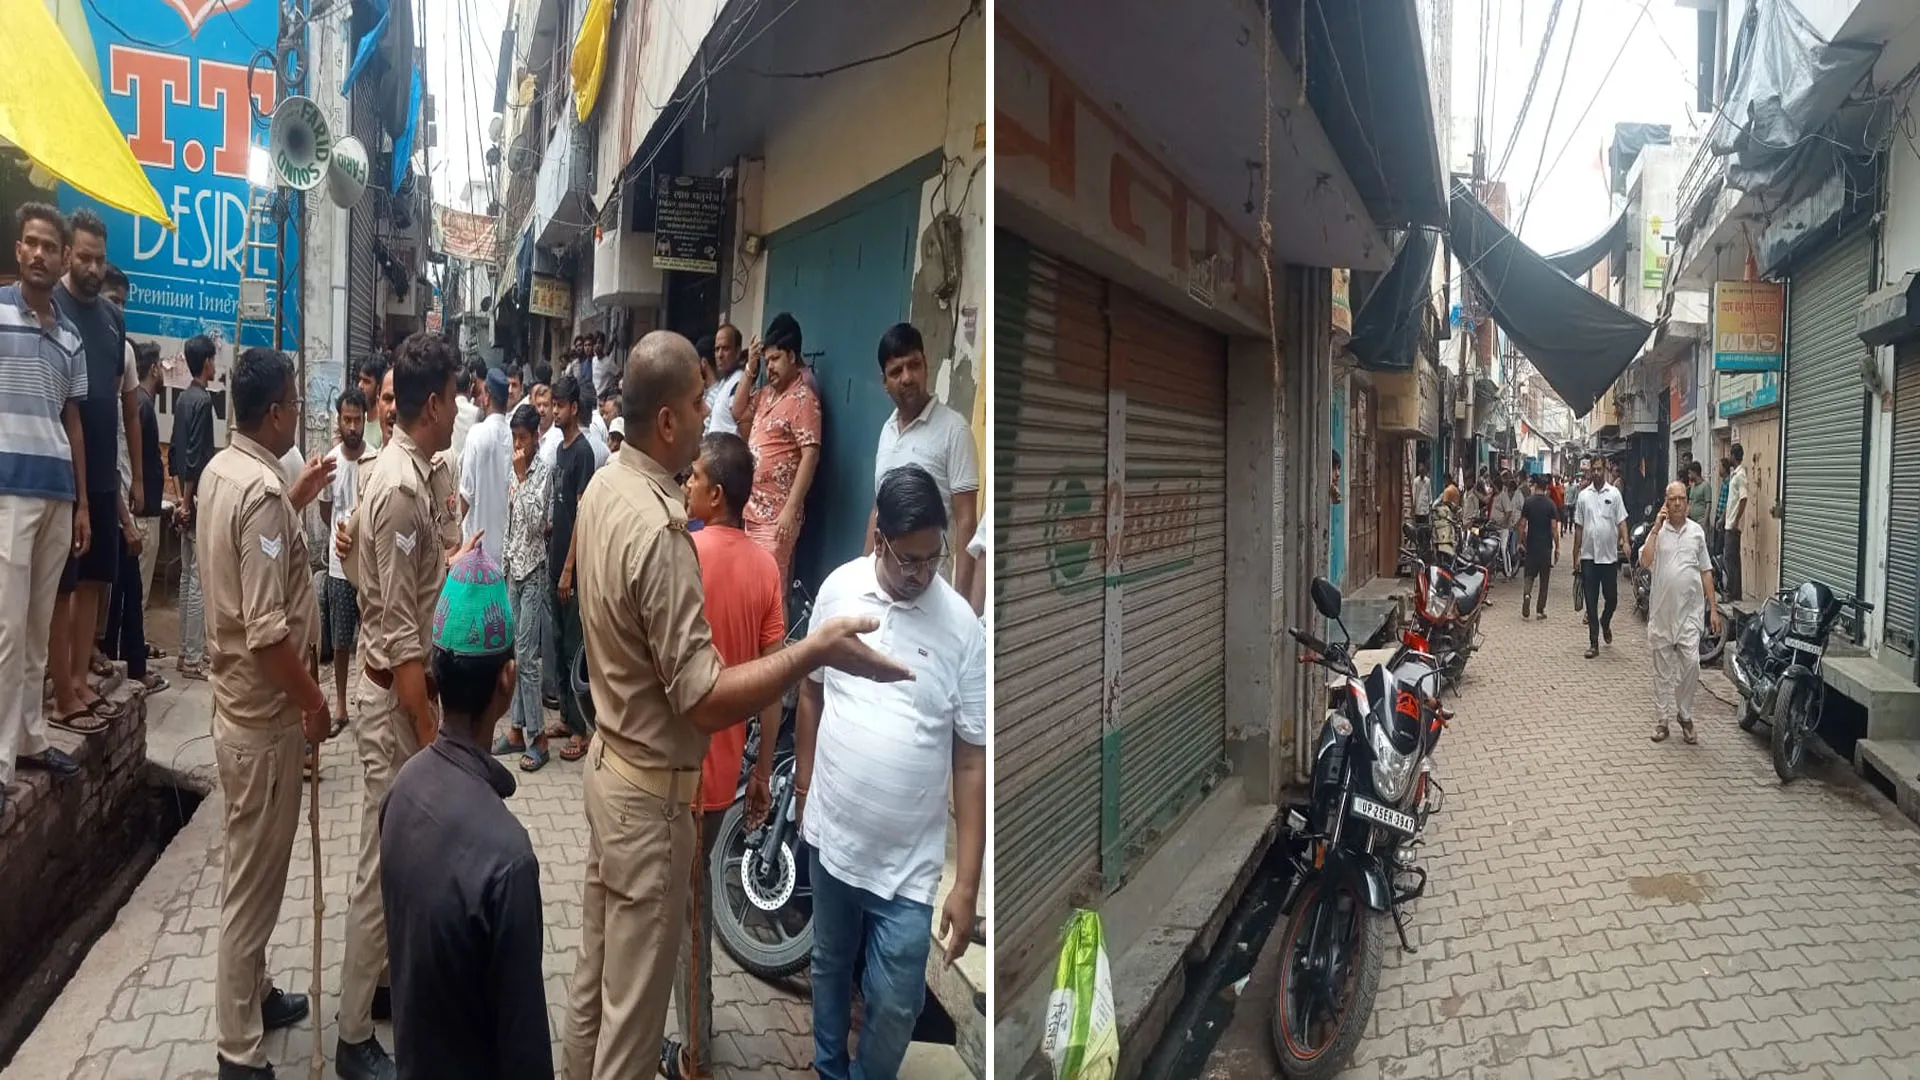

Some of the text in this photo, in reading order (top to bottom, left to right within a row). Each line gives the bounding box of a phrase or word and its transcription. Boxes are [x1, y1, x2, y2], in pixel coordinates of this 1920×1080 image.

[277, 101, 330, 186] FARID SOUND
[134, 185, 269, 276] DESIRE
[129, 283, 194, 311] Premium
